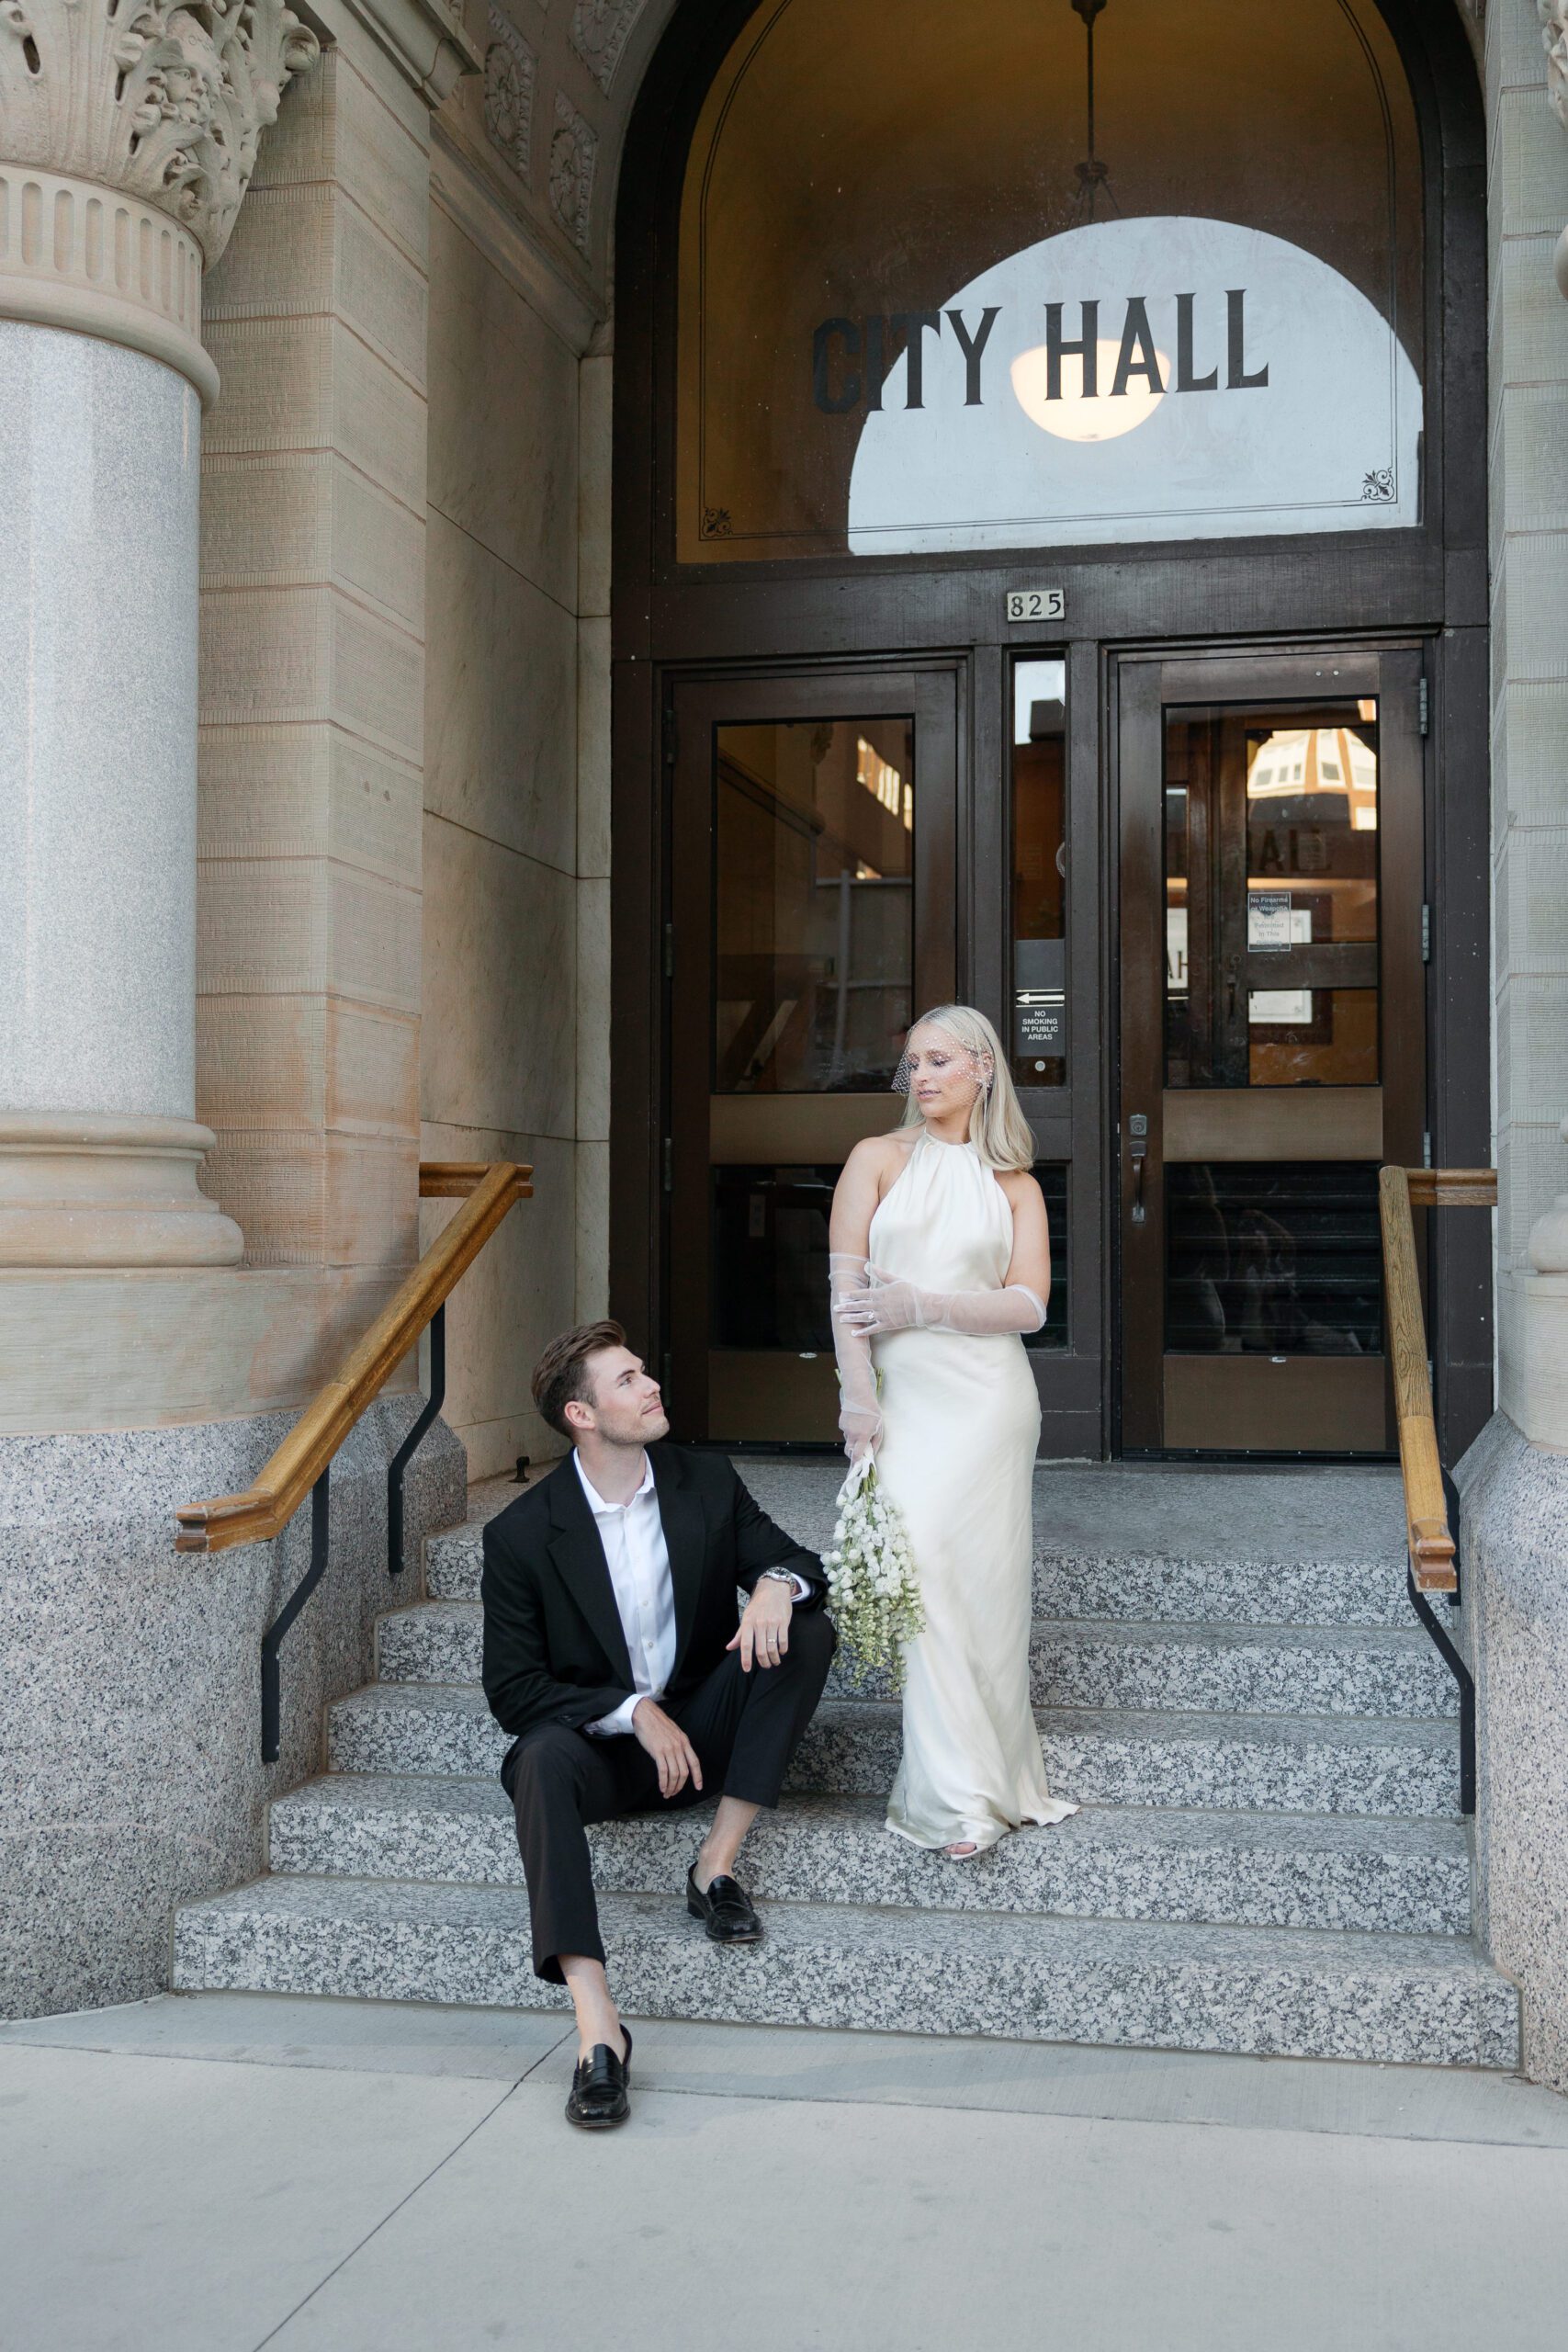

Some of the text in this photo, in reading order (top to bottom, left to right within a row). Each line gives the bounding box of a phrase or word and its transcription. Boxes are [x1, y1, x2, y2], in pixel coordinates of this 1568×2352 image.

[813, 288, 1269, 414] CITY HALL
[1010, 593, 1062, 617] 825
